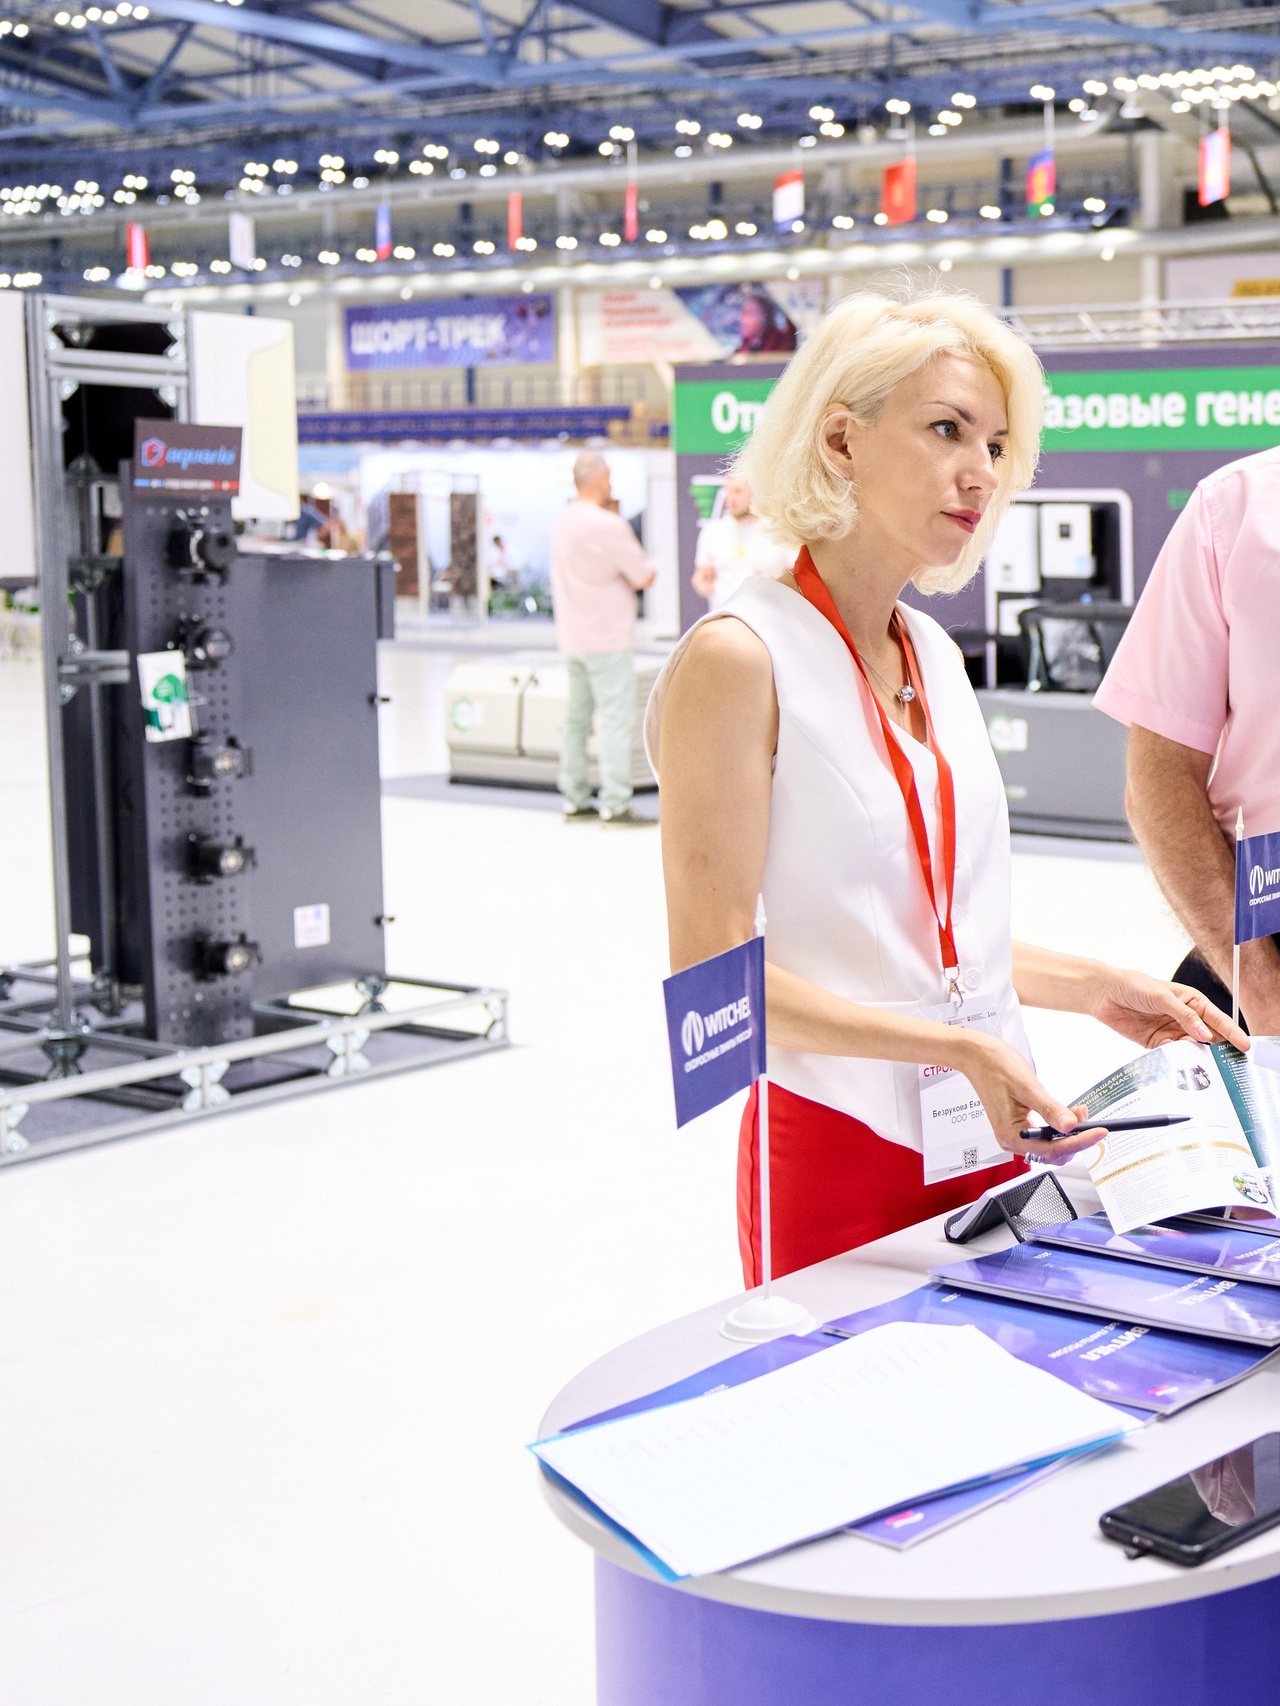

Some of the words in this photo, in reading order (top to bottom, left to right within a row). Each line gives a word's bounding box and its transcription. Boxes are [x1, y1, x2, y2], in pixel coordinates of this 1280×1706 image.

[351, 314, 507, 355] ШОРТ-ТРЕК
[1042, 392, 1187, 429] азовые
[932, 1103, 968, 1119] Безрукова
[969, 1100, 982, 1110] Ека
[951, 1112, 968, 1125] ООО
[1176, 1280, 1239, 1307] ВИТЧЕЛ
[1079, 1326, 1150, 1362] ВИТЧЕЛ
